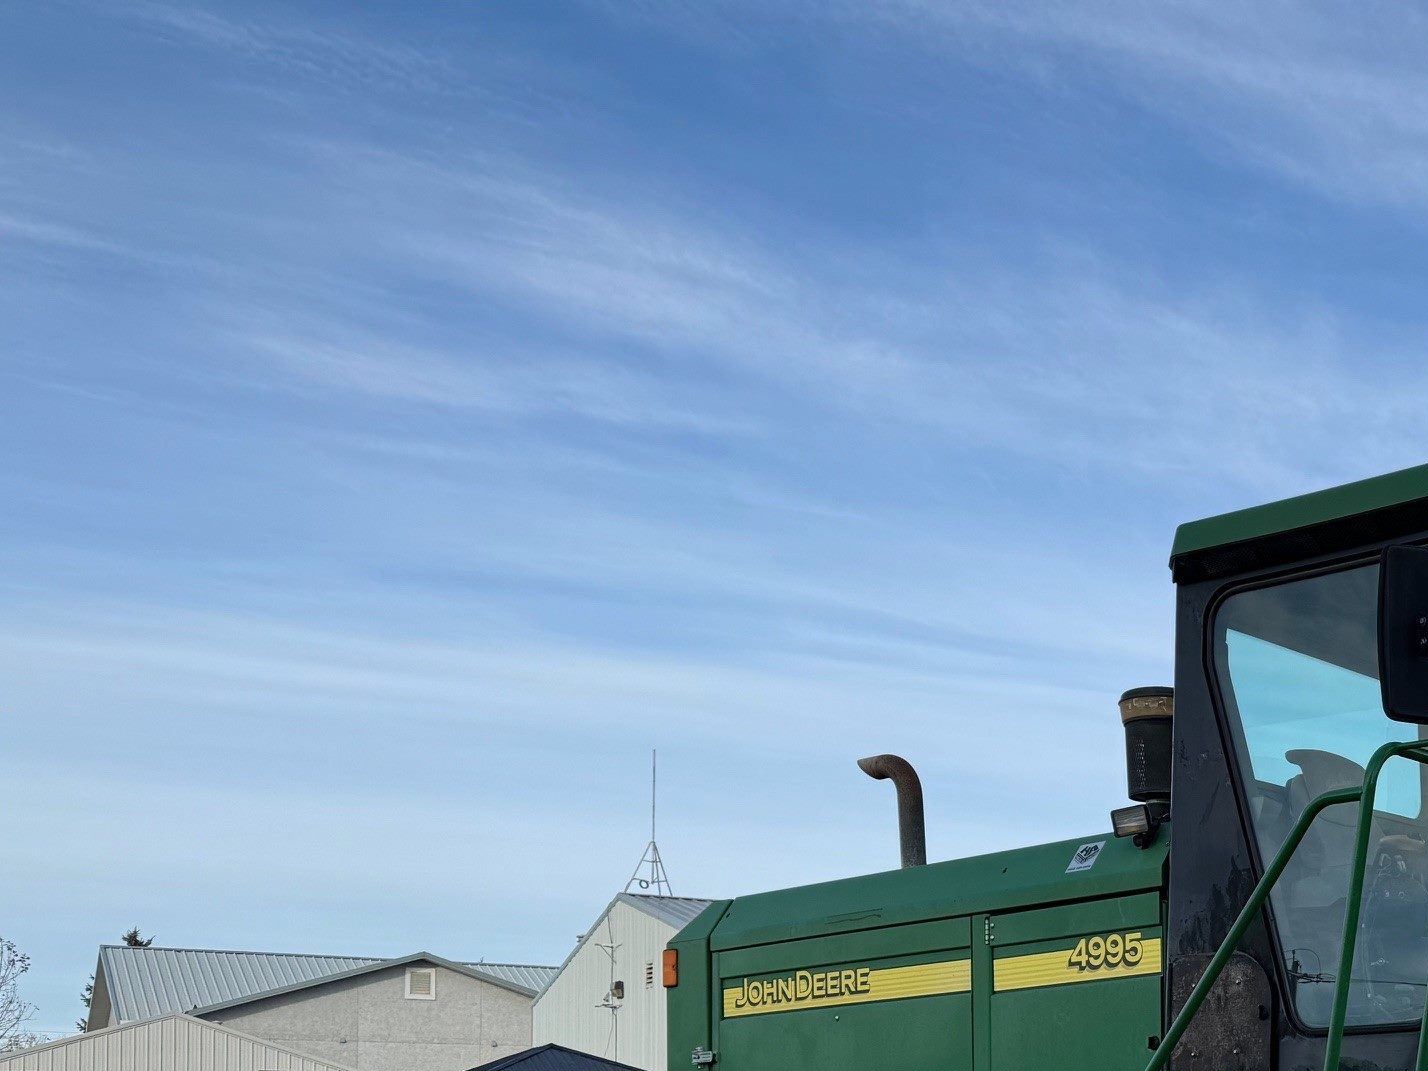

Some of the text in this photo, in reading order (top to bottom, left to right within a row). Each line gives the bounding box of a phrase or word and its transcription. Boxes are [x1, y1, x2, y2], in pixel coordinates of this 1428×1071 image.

[1068, 932, 1143, 972] 4995
[735, 967, 871, 1007] JOHN DEERE
